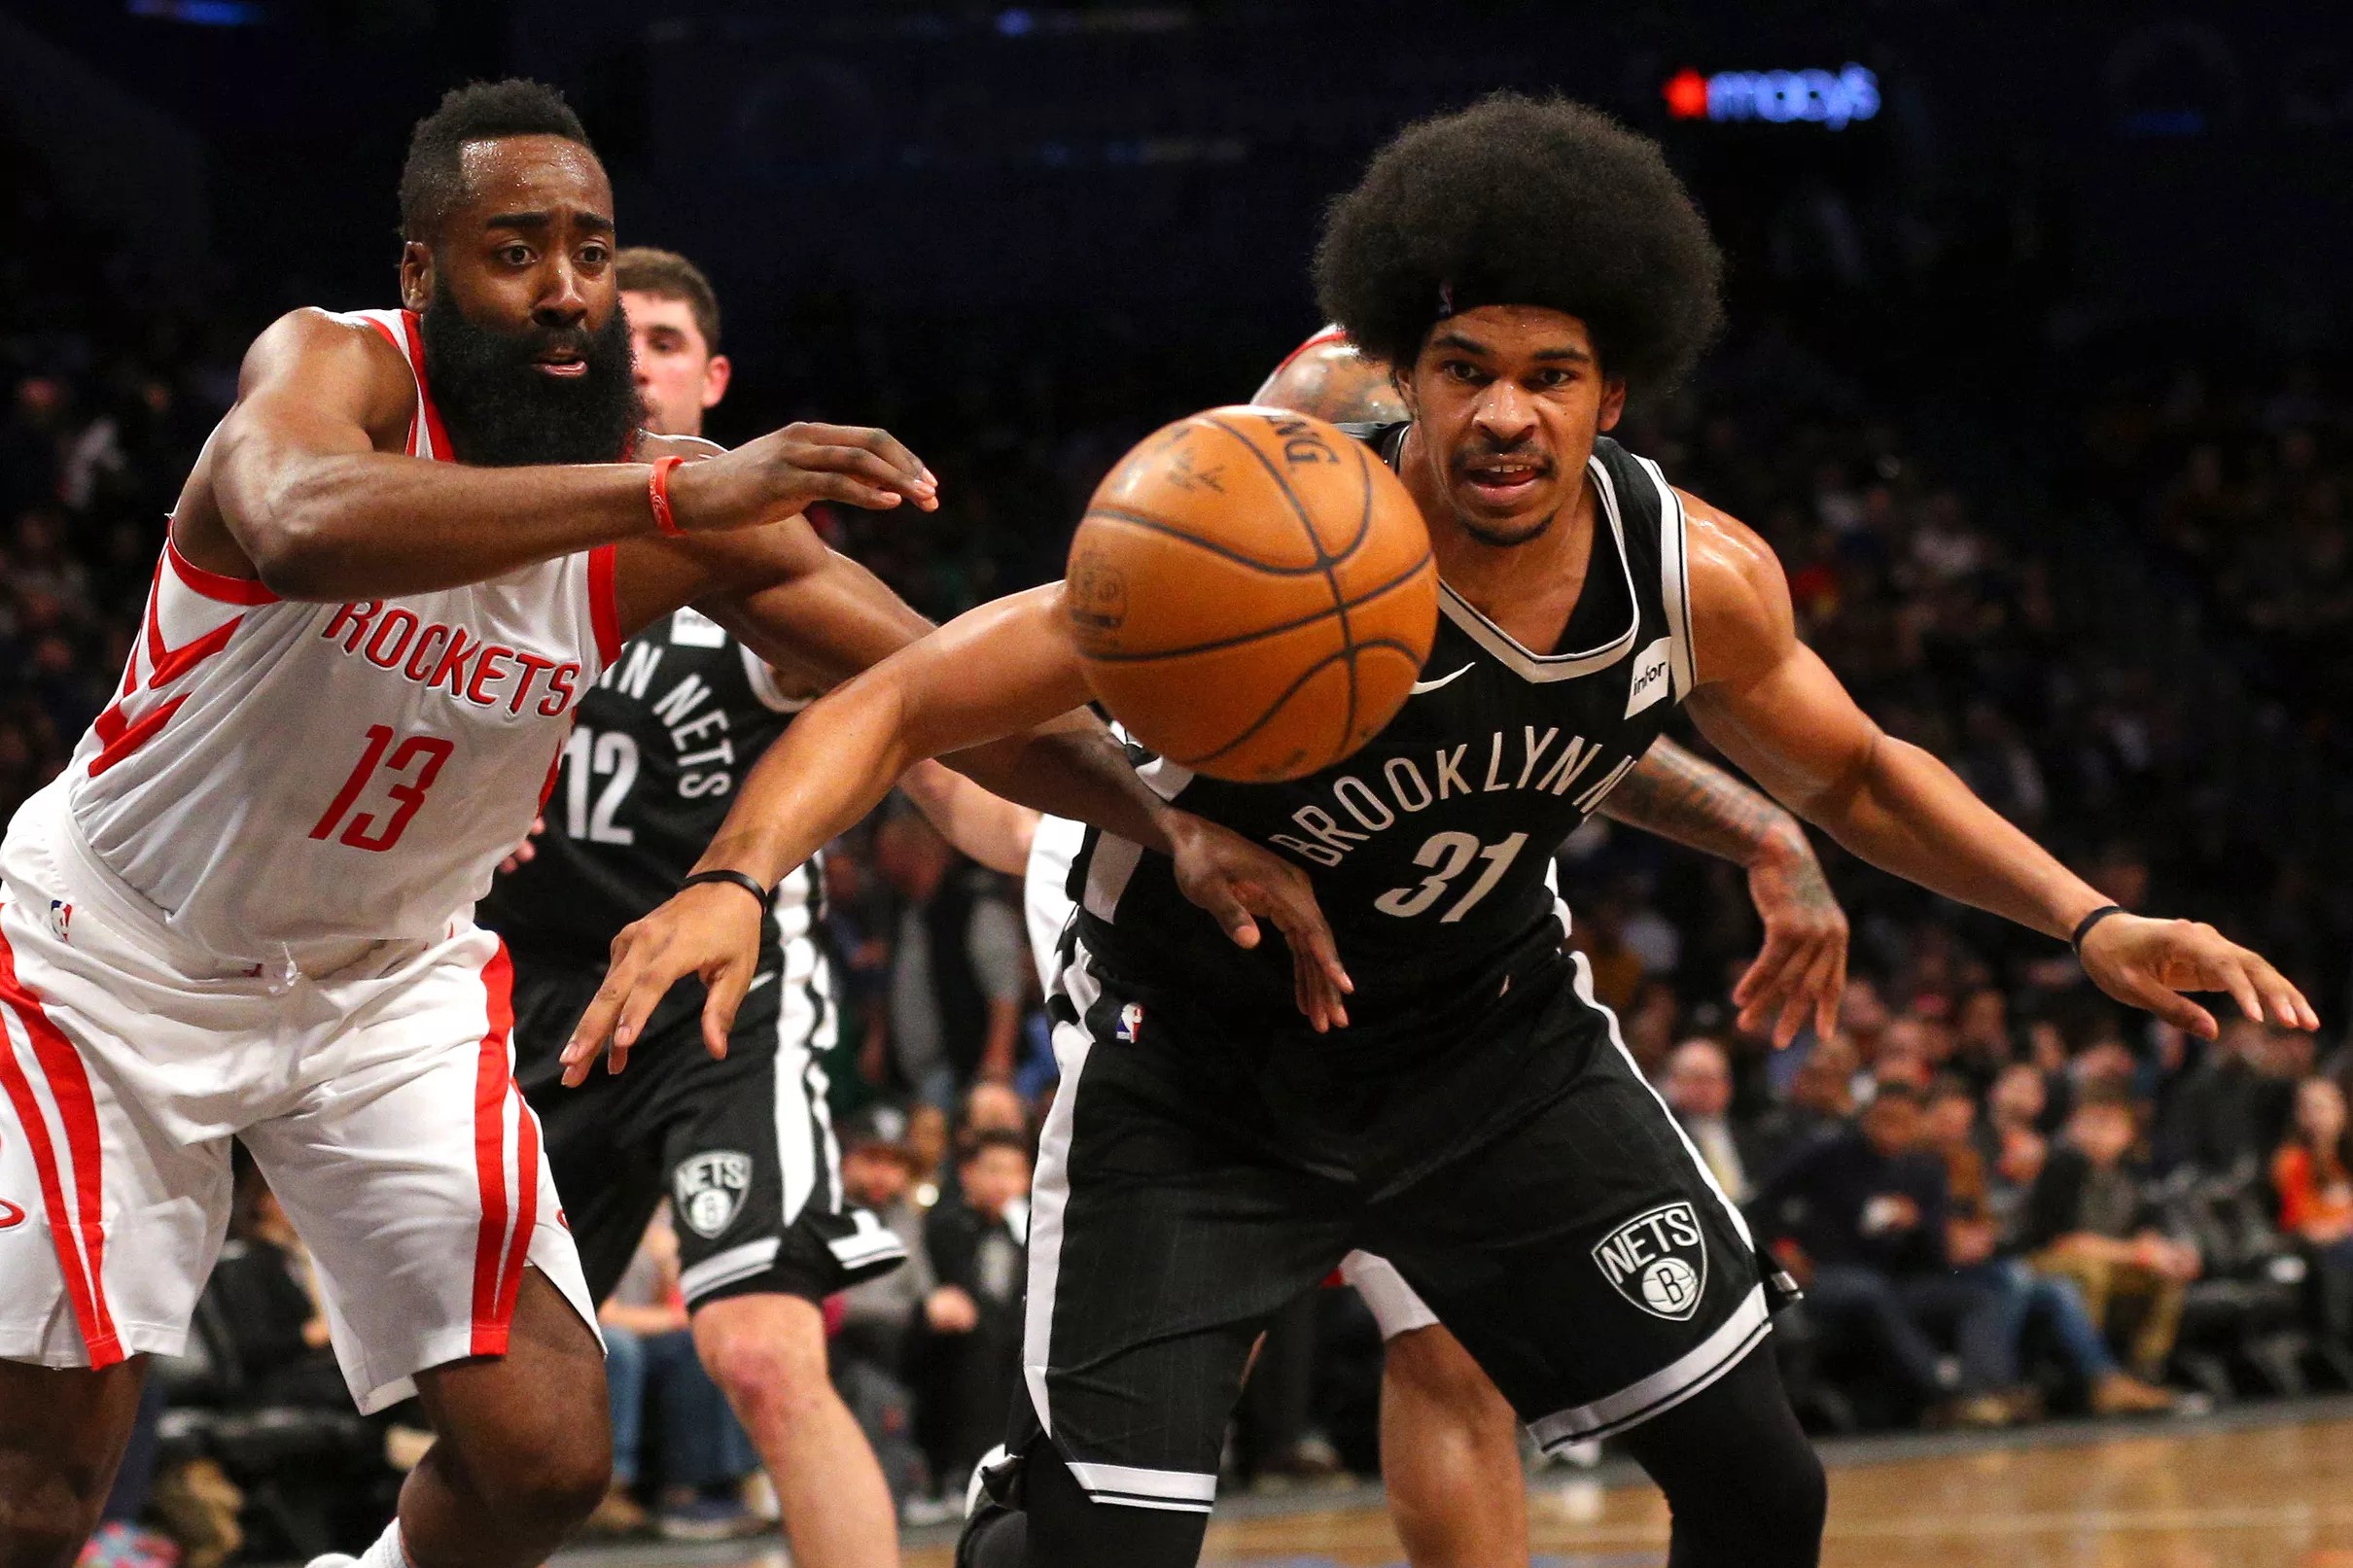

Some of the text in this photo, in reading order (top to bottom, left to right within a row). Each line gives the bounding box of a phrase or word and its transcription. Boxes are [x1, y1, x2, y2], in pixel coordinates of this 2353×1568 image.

[322, 598, 580, 718] ROCKETS
[1633, 662, 1666, 696] infor
[308, 724, 455, 853] 13
[561, 724, 639, 845] 12
[651, 673, 735, 799] NETS
[1268, 725, 1603, 867] BROOKLYN
[1373, 830, 1529, 923] 31
[675, 1156, 748, 1202] NETS
[1600, 1208, 1700, 1284] NETS
[1657, 1267, 1684, 1306] B
